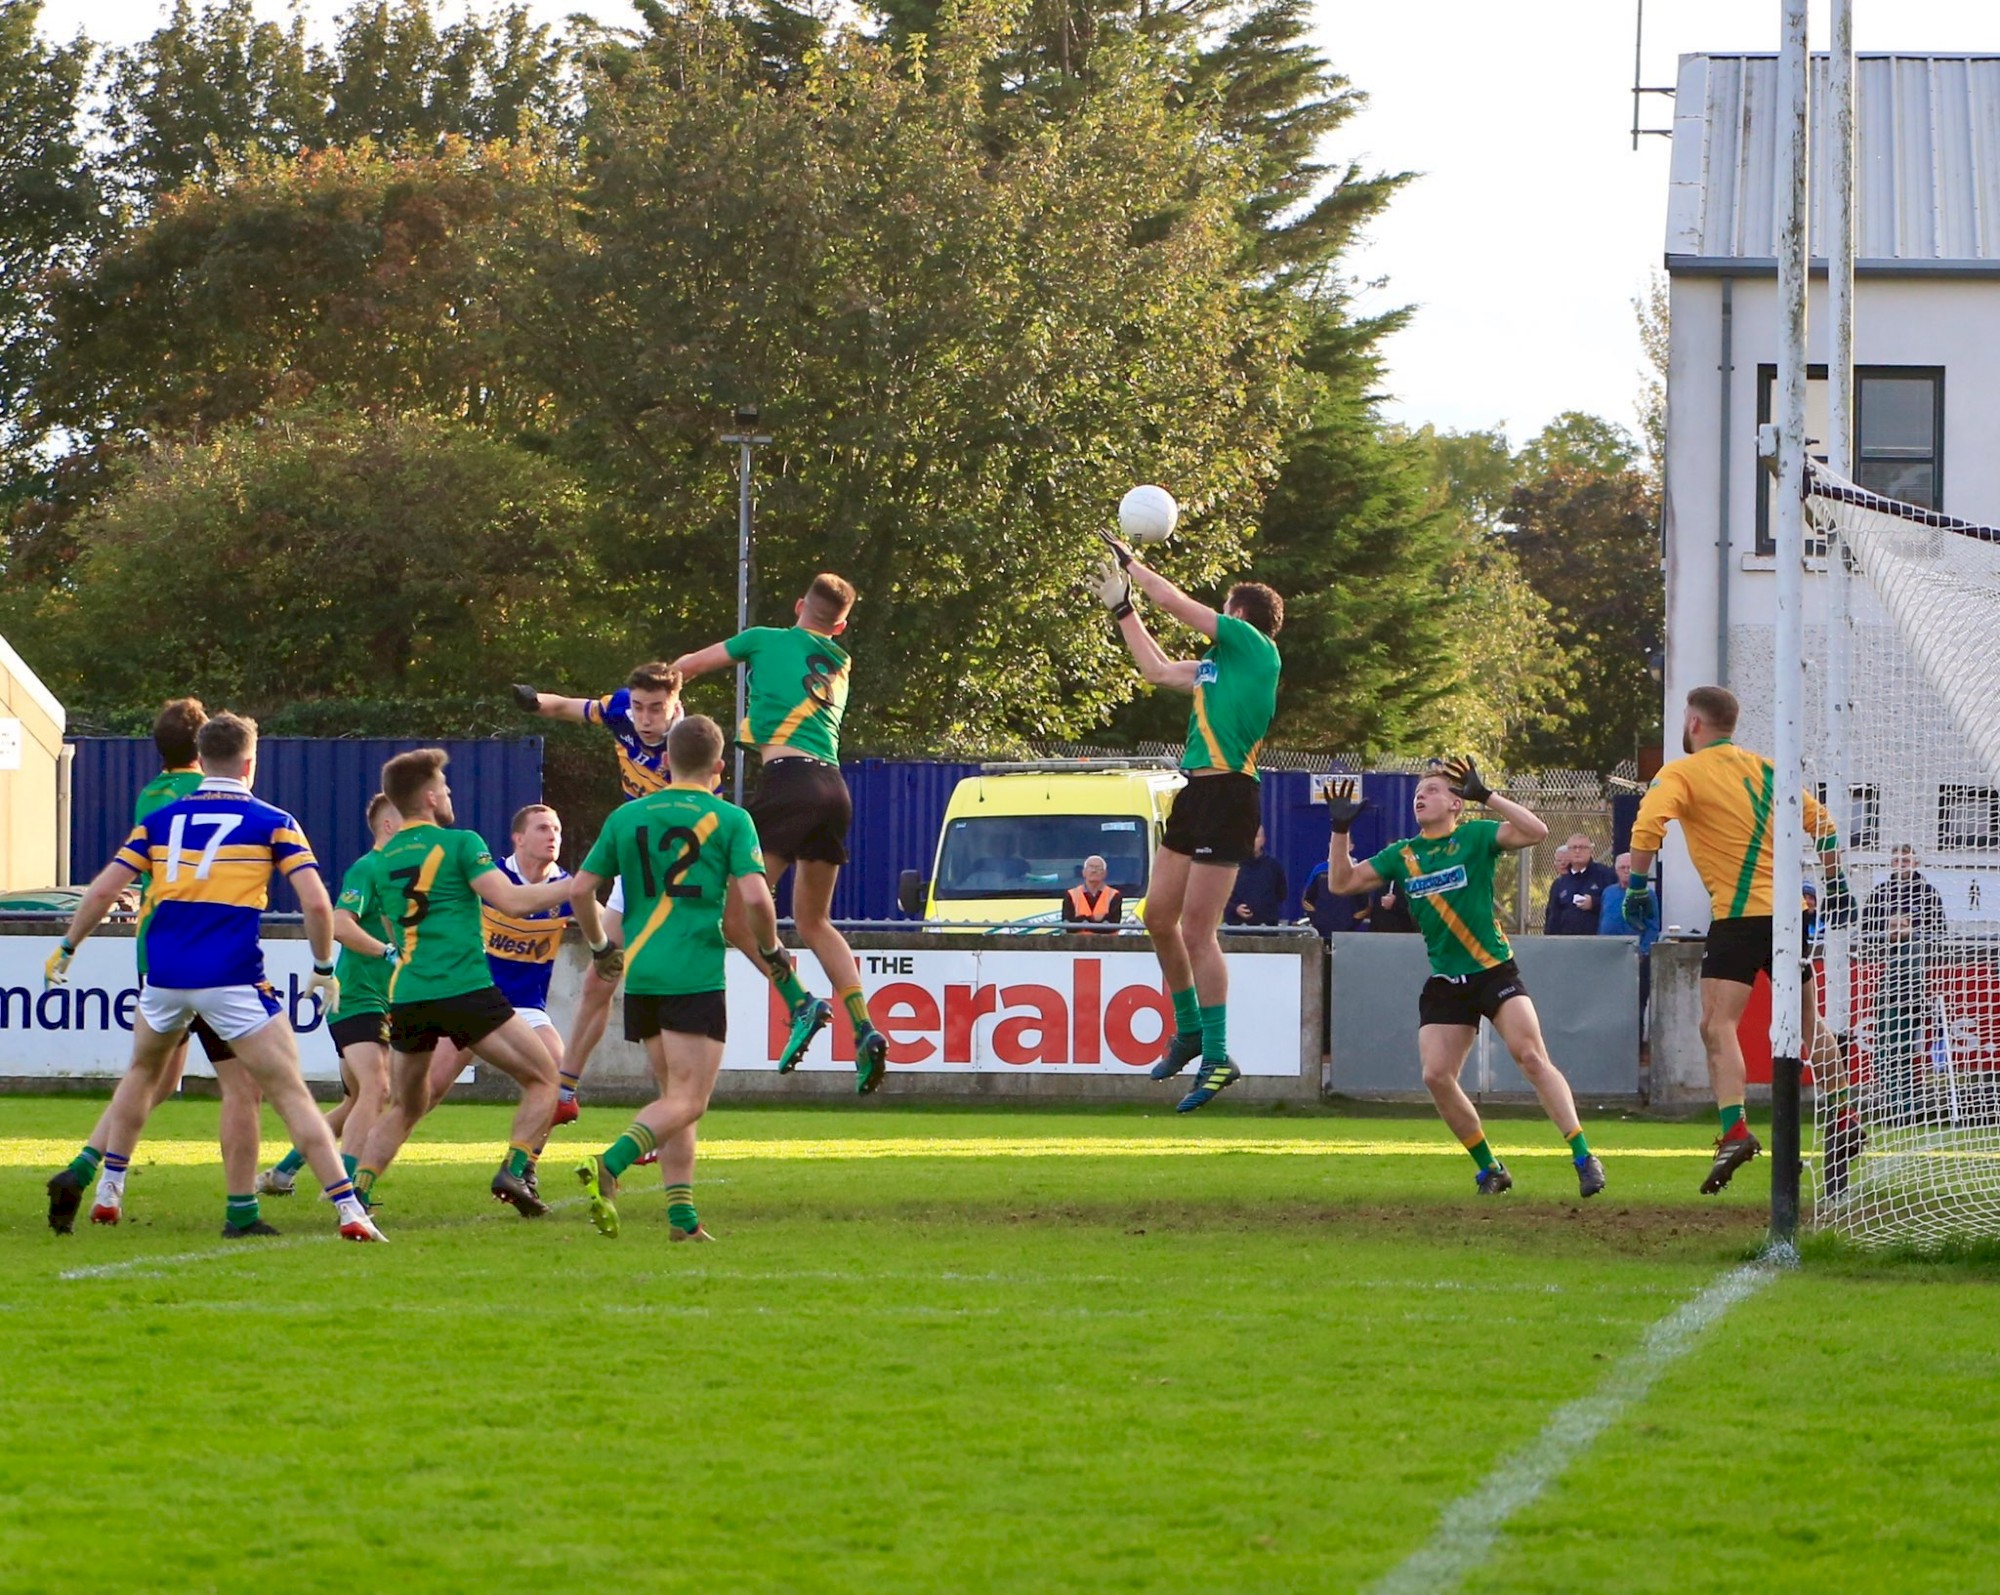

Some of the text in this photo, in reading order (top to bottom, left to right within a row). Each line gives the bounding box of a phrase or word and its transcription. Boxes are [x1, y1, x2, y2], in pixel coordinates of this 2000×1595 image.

[802, 654, 837, 708] 8
[166, 813, 244, 883] 17
[636, 826, 702, 897] 12
[389, 865, 430, 928] 3
[489, 932, 536, 955] West
[867, 956, 913, 974] THE
[0, 987, 141, 1031] mane
[768, 956, 1176, 1066] Herald
